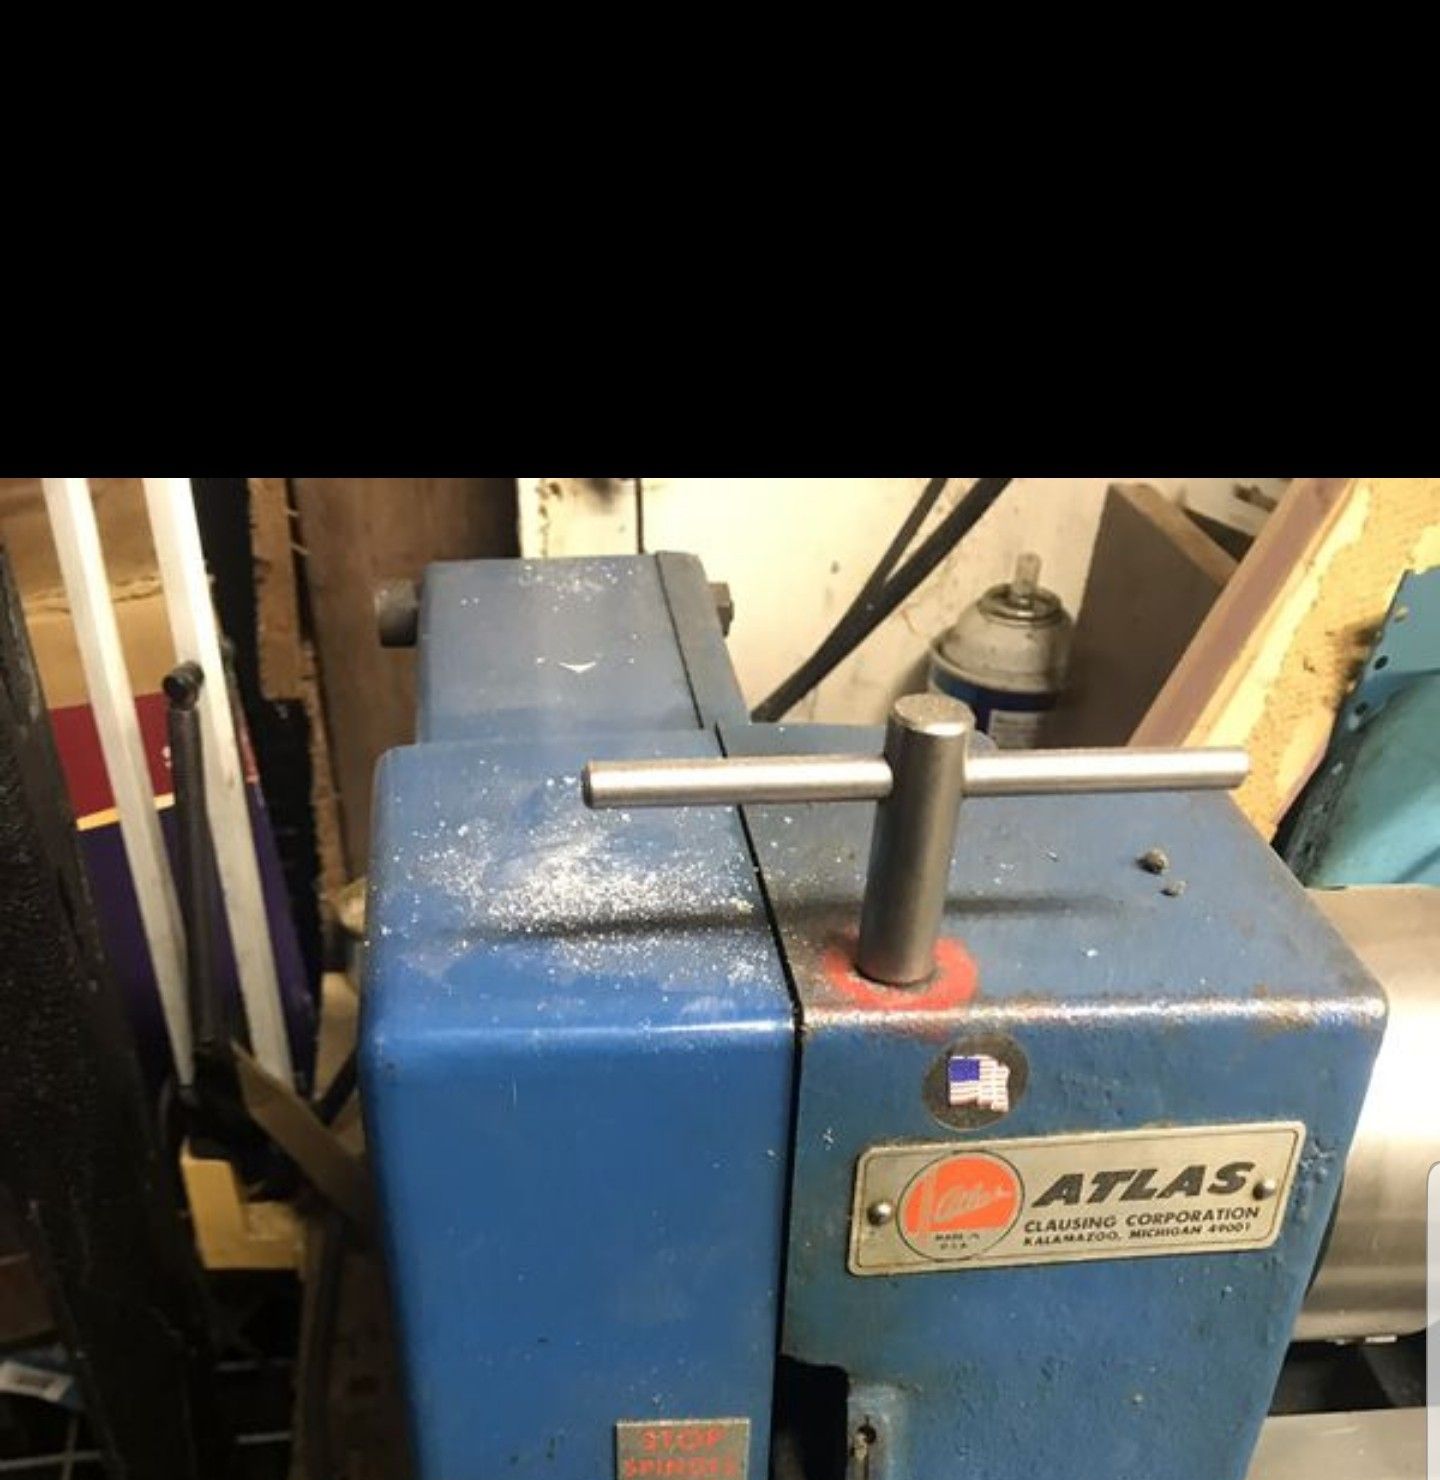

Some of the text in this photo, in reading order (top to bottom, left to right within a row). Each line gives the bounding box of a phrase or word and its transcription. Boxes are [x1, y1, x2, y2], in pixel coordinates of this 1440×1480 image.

[1031, 1161, 1257, 1208] ATLAS
[1024, 1207, 1260, 1233] CLAUSING CORPORATION
[1128, 1225, 1203, 1239] MICHIGAN
[642, 1427, 726, 1452] STOP
